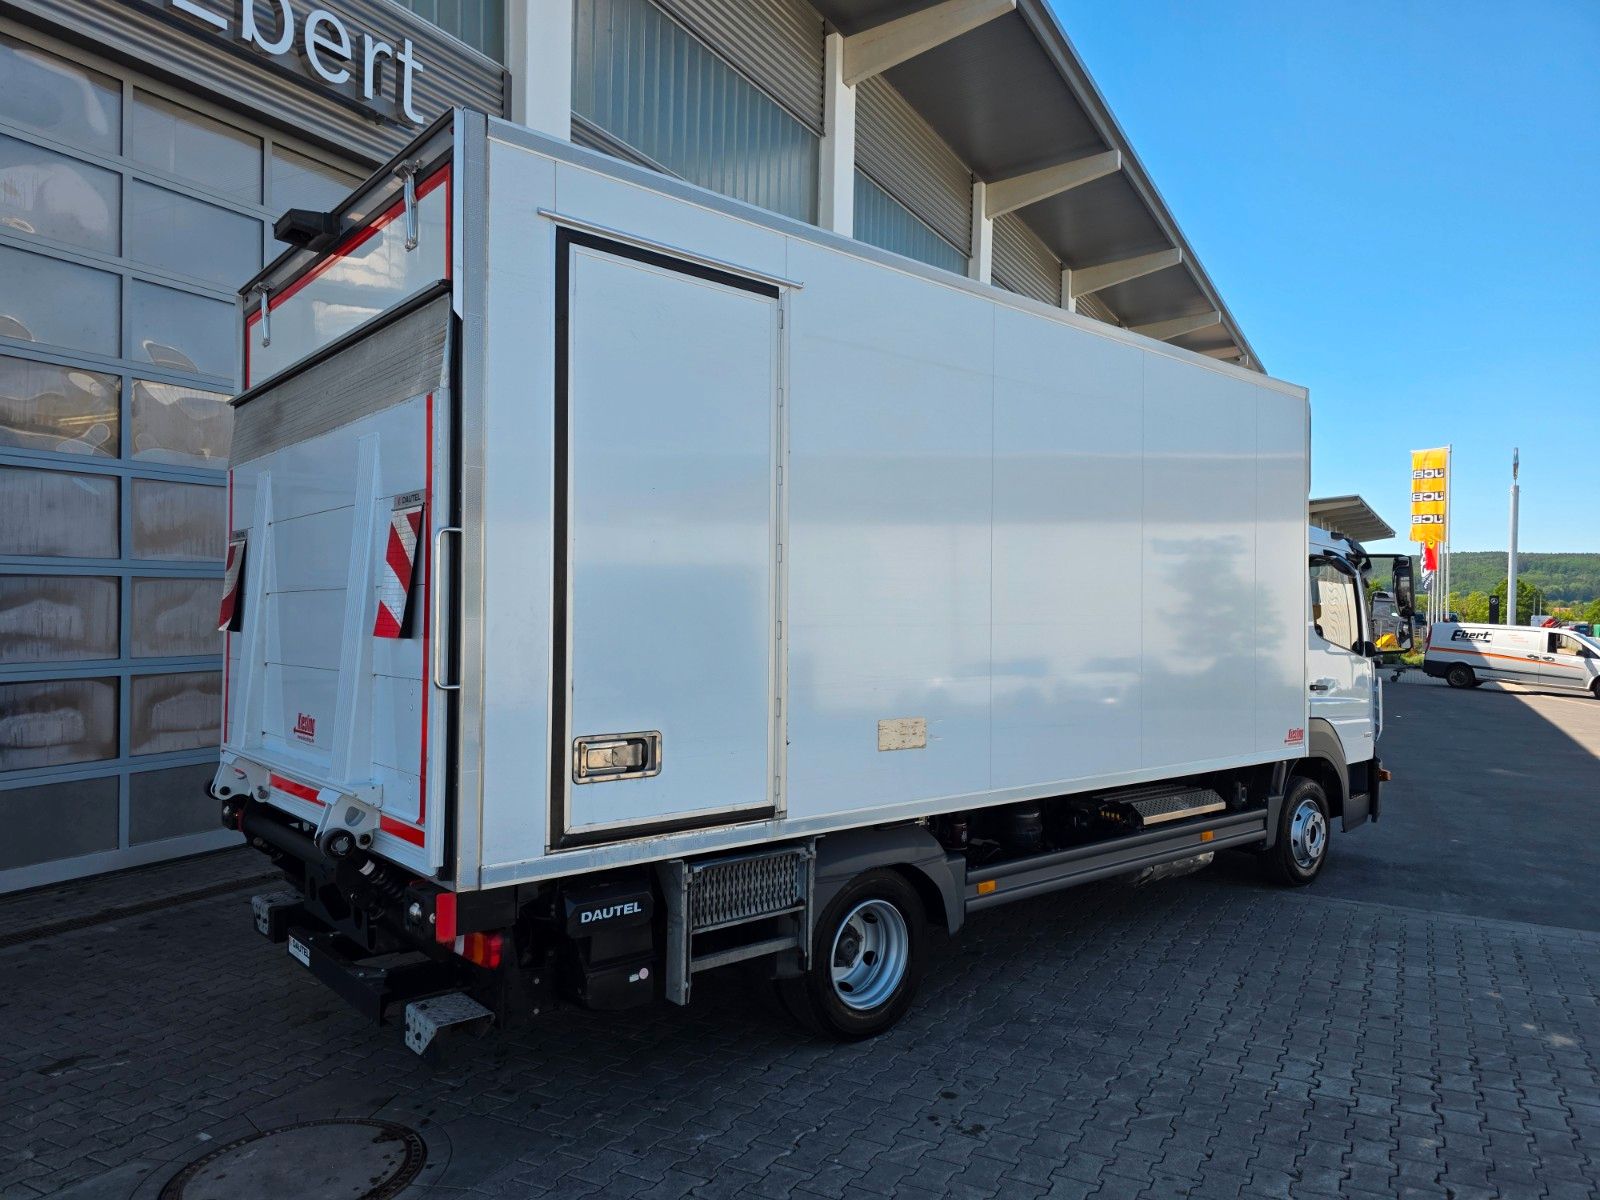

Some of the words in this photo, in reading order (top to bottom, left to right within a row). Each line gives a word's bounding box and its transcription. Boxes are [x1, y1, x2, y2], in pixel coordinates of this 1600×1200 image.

[172, 0, 424, 124] bert
[1451, 630, 1492, 641] Ebert
[581, 902, 641, 923] DAUTEL
